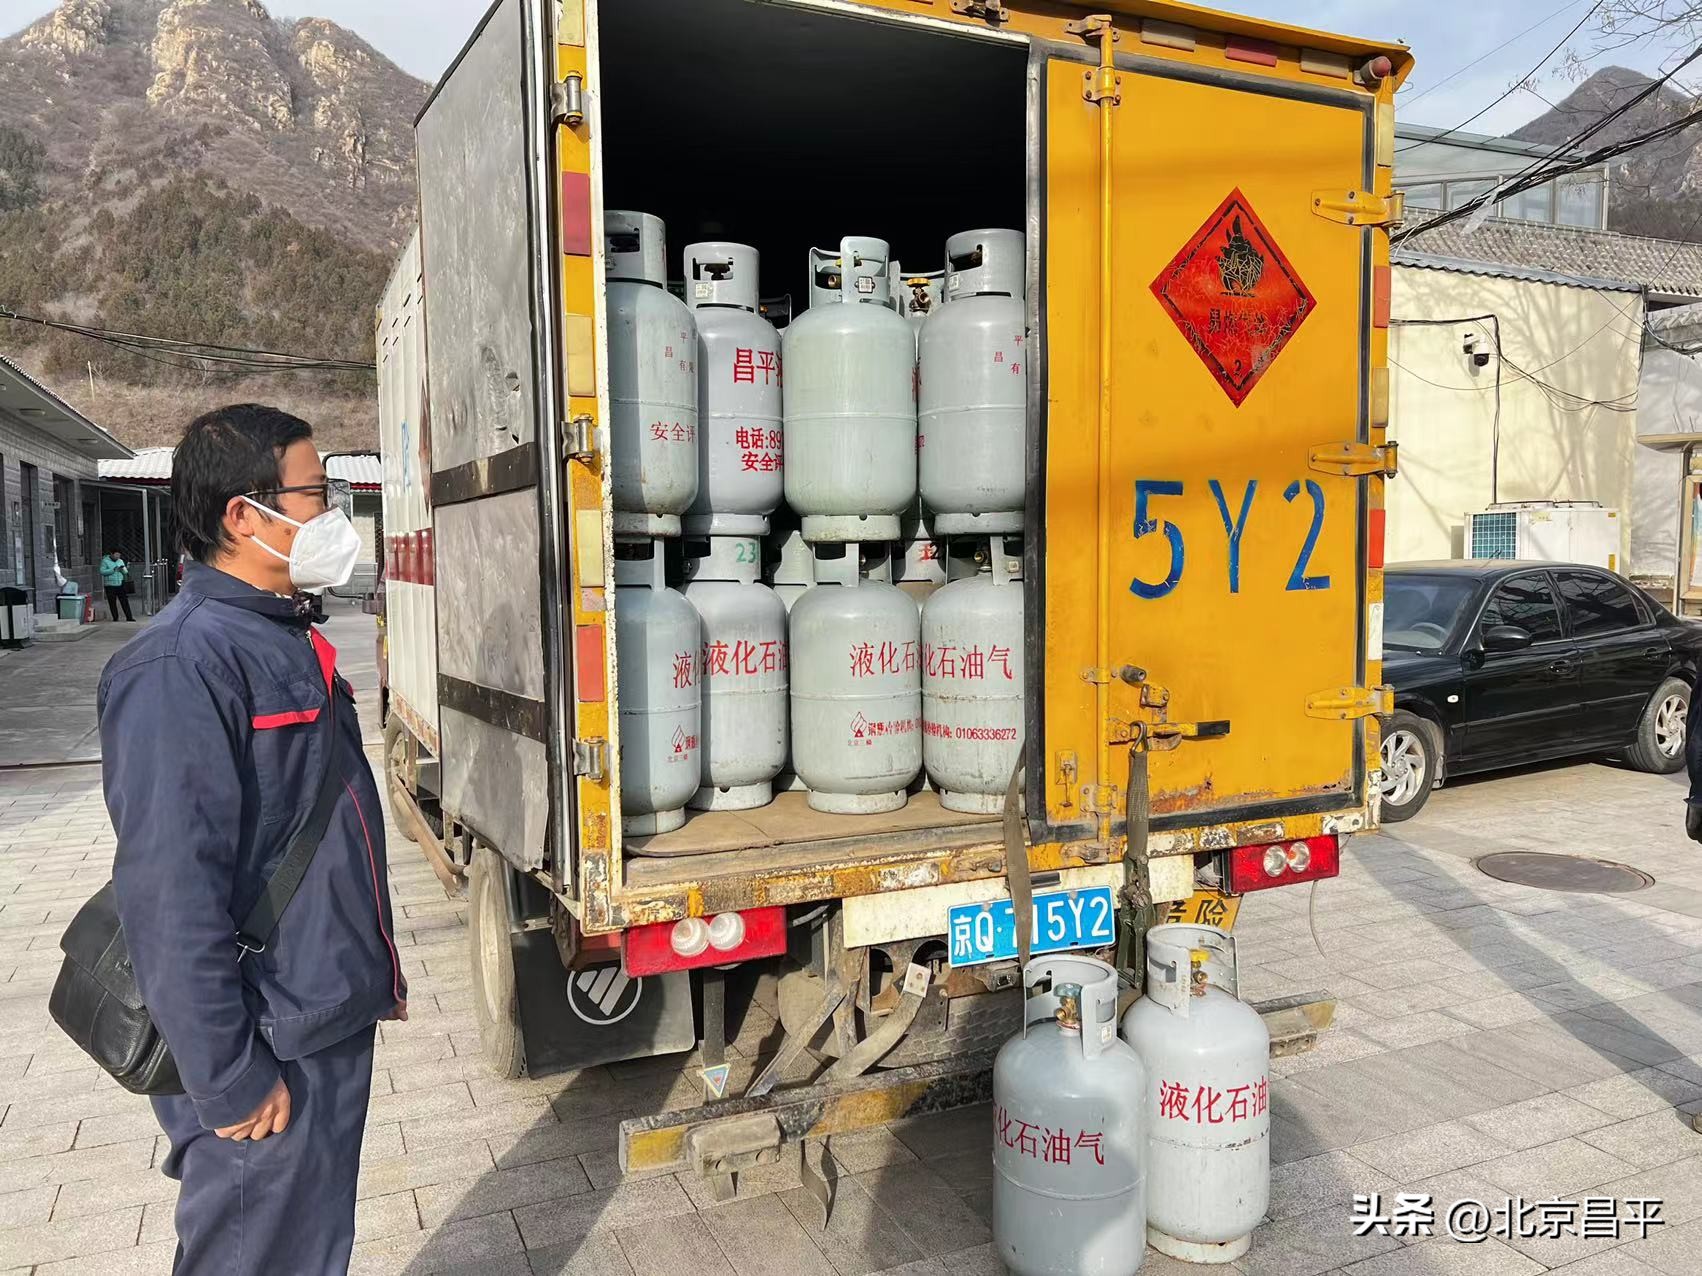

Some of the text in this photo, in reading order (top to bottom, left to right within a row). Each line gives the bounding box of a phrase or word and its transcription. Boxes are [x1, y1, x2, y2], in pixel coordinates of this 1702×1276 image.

[1233, 359, 1243, 375] 2
[735, 426, 783, 450] 电话:89
[1129, 479, 1331, 600] 5Y2
[735, 542, 758, 564] 23
[955, 727, 1017, 741] 01063336272
[1159, 1075, 1267, 1125] 液化石油
[993, 1105, 1105, 1166] 化石油气
